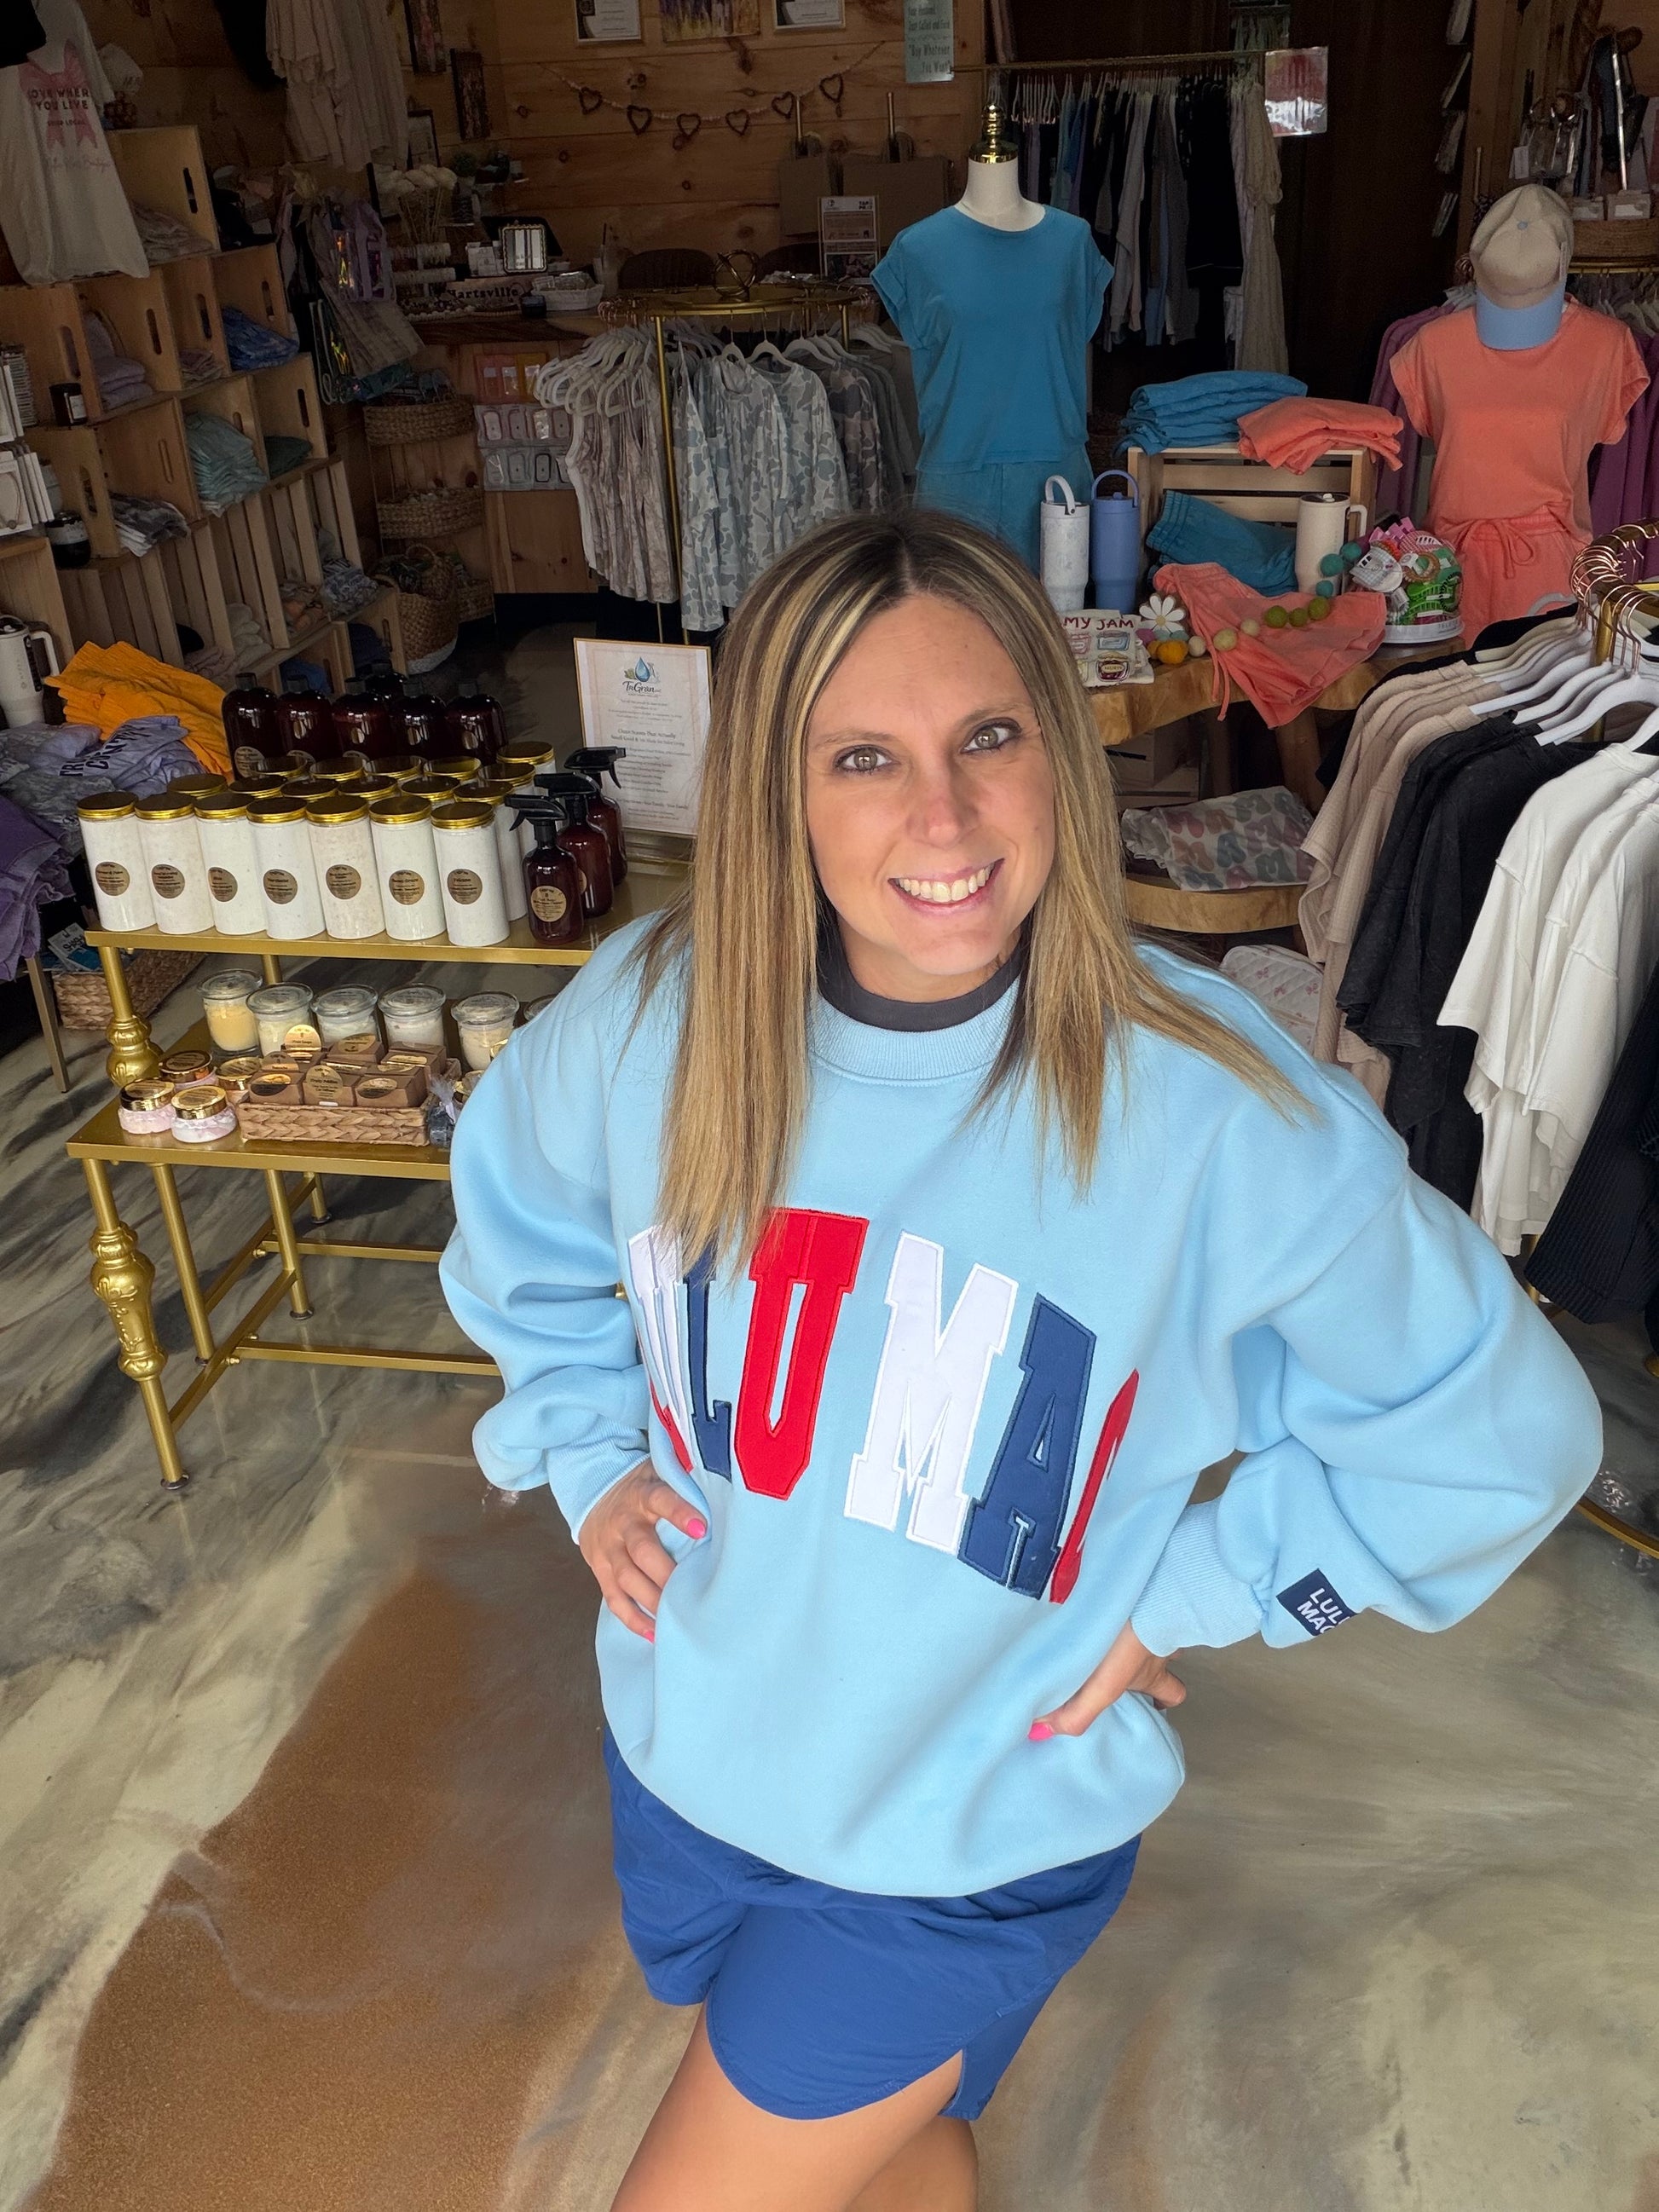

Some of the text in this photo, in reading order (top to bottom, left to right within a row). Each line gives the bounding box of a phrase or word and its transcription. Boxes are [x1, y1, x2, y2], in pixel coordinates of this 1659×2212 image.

[57, 88, 90, 97] WHER
[36, 100, 89, 110] YOU LIVE
[1063, 617, 1134, 630] MY JAM
[1309, 1588, 1350, 1625] LUL
